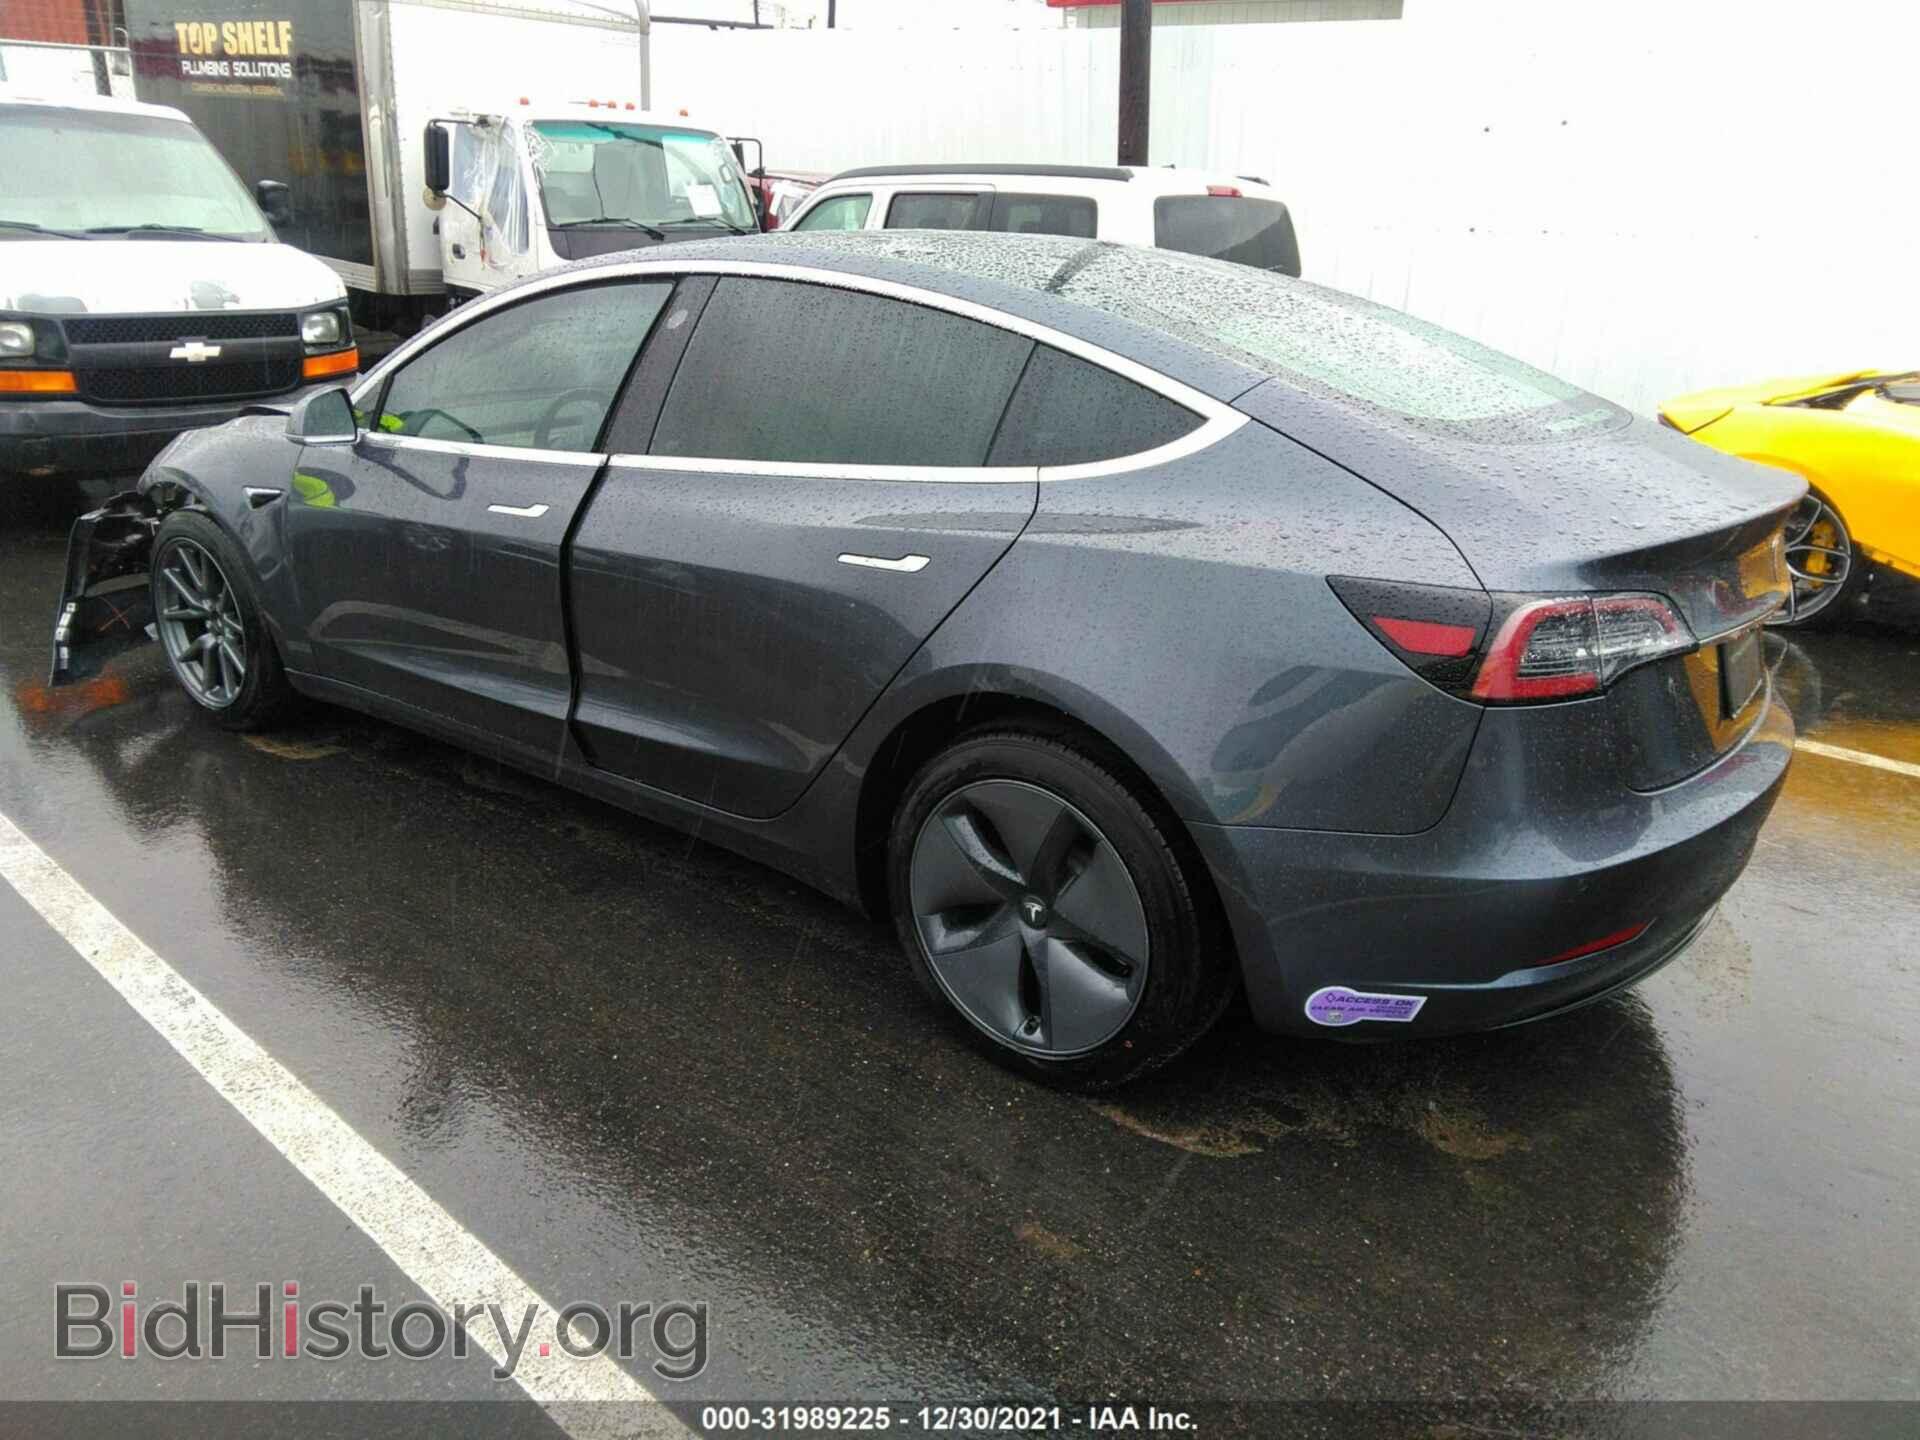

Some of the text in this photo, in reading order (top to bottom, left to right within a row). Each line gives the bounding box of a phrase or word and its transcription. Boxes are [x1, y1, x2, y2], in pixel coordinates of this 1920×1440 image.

[175, 21, 292, 56] TOP SHELF
[181, 60, 292, 78] PLUMBING SOLUTIONS
